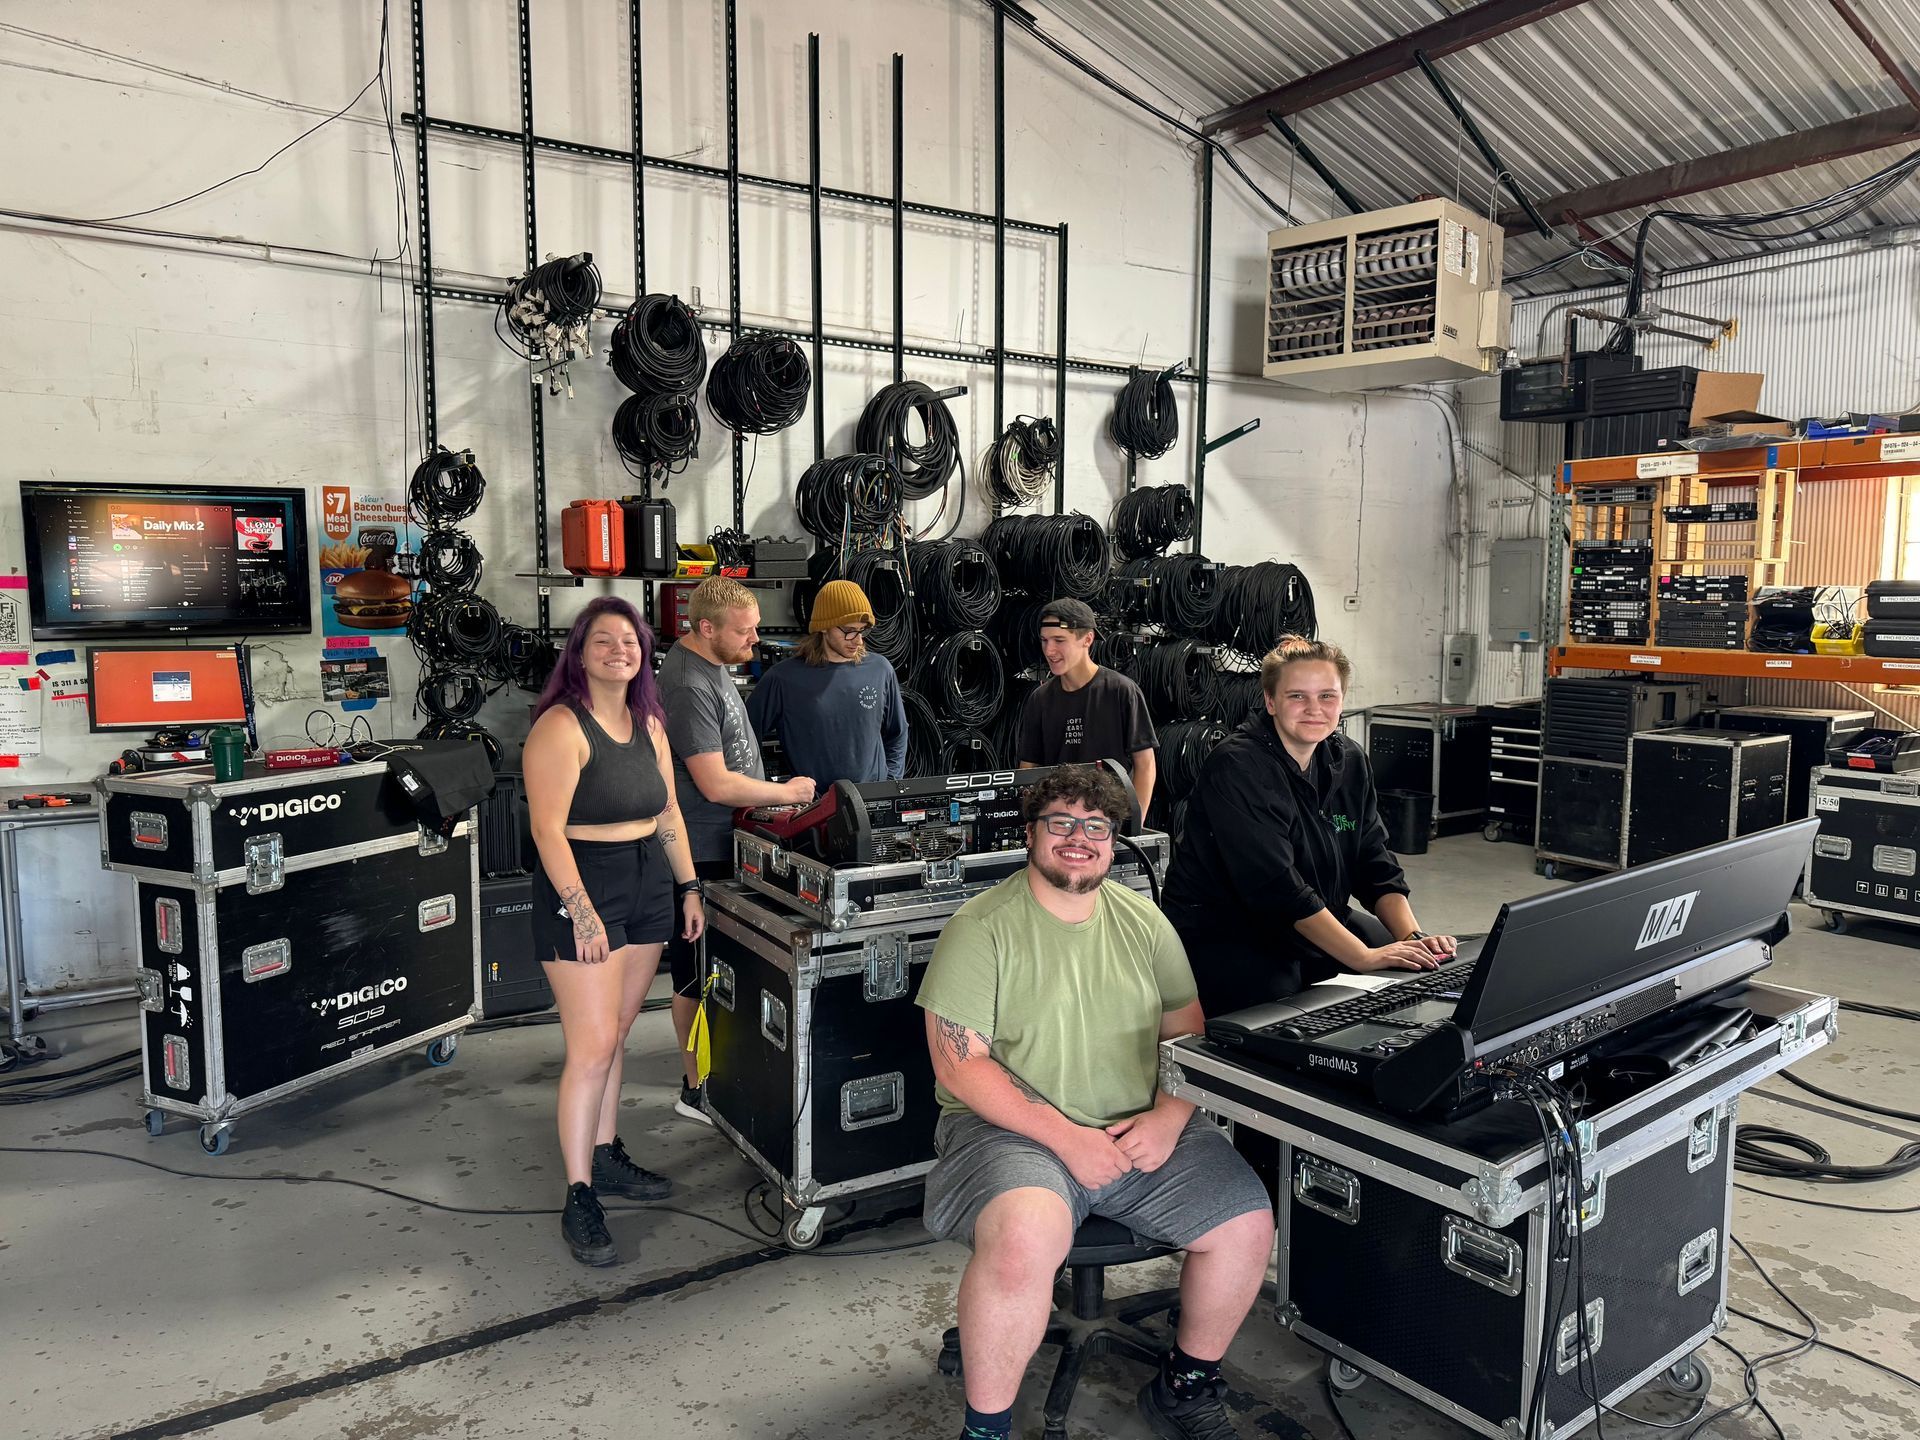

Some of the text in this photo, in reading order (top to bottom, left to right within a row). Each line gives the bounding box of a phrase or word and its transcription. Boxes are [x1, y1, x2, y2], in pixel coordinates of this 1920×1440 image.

[326, 492, 347, 514] $7
[354, 502, 382, 512] Bacon
[326, 513, 349, 523] Meal
[143, 520, 205, 532] Daily Mix 2
[327, 523, 349, 533] Deal
[945, 771, 1015, 790] SD9
[1817, 797, 1839, 807] 15/50
[495, 902, 534, 915] PELICAN
[1639, 895, 1690, 946] MA
[337, 1004, 386, 1030] SD9
[1308, 1053, 1358, 1074] grandMA3
